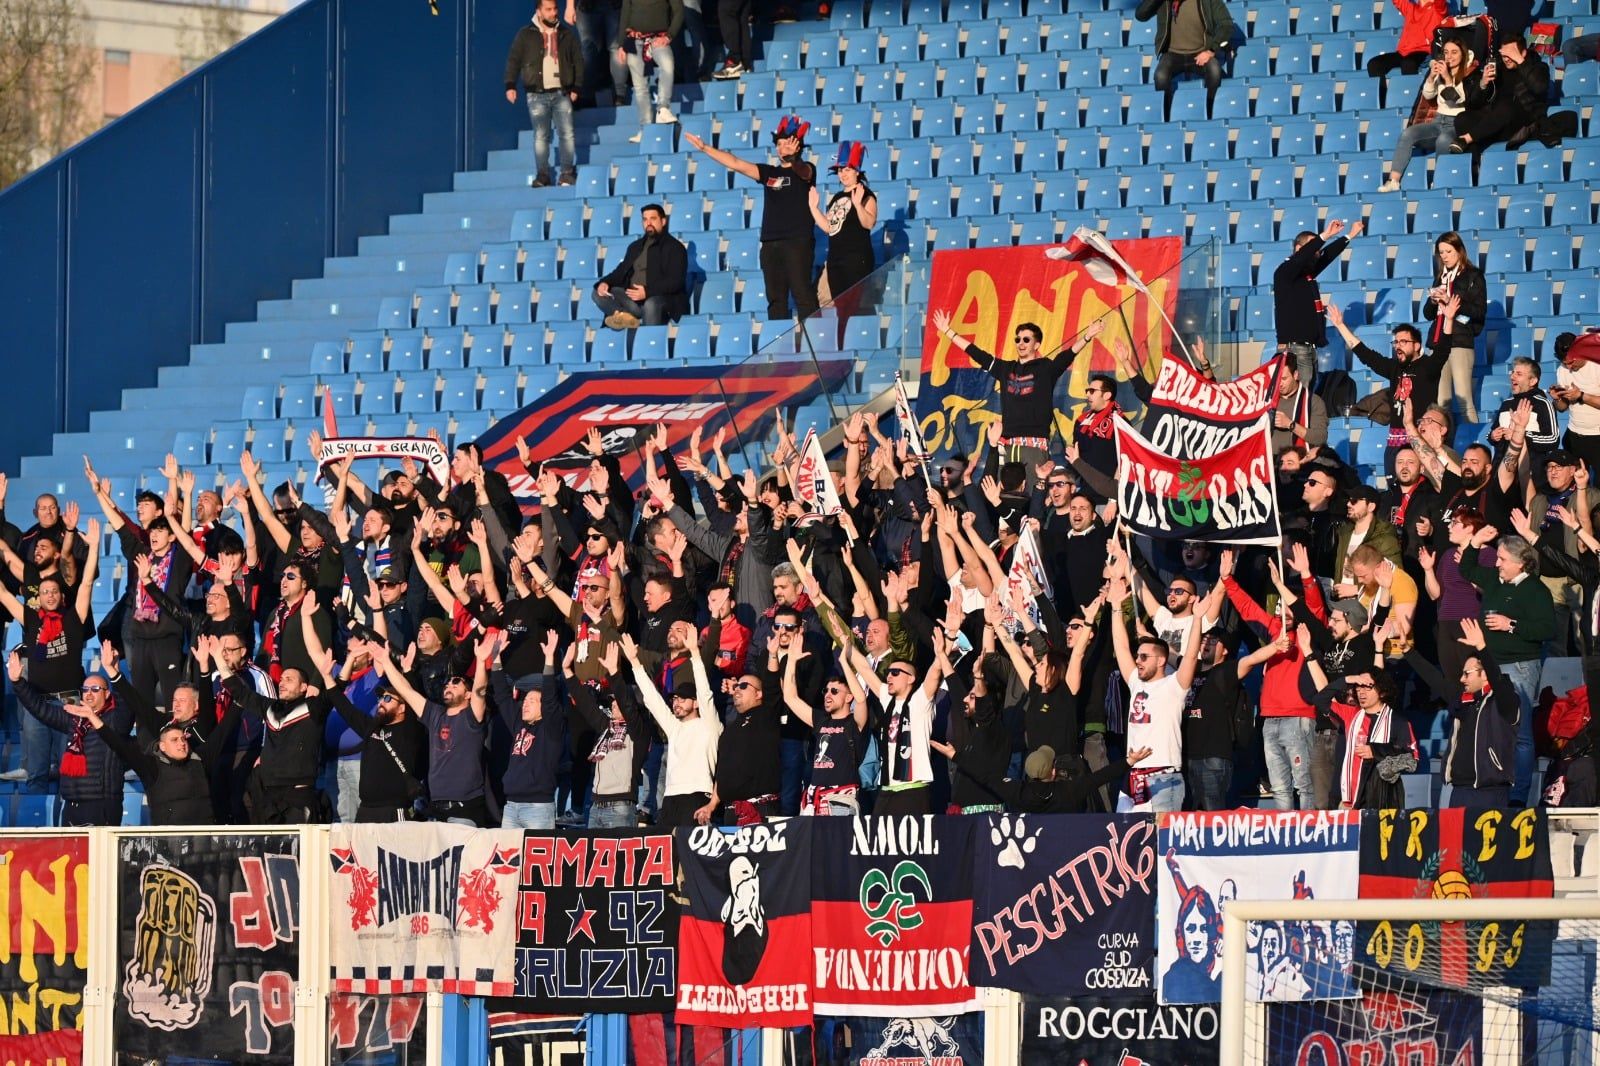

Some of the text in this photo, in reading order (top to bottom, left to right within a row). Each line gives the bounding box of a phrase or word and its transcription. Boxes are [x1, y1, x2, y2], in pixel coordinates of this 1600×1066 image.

[578, 402, 728, 422] LUZZI
[850, 814, 939, 856] TOWN
[1168, 809, 1350, 852] MAI DIMENTICATI
[519, 834, 675, 888] RMATA
[608, 889, 665, 944] 92
[1097, 931, 1140, 950] CURVA
[1103, 950, 1132, 968] SUD
[1085, 966, 1151, 989] COSENZA
[676, 983, 809, 1016] IRREQUIETI
[1037, 1005, 1219, 1041] ROGGIANO
